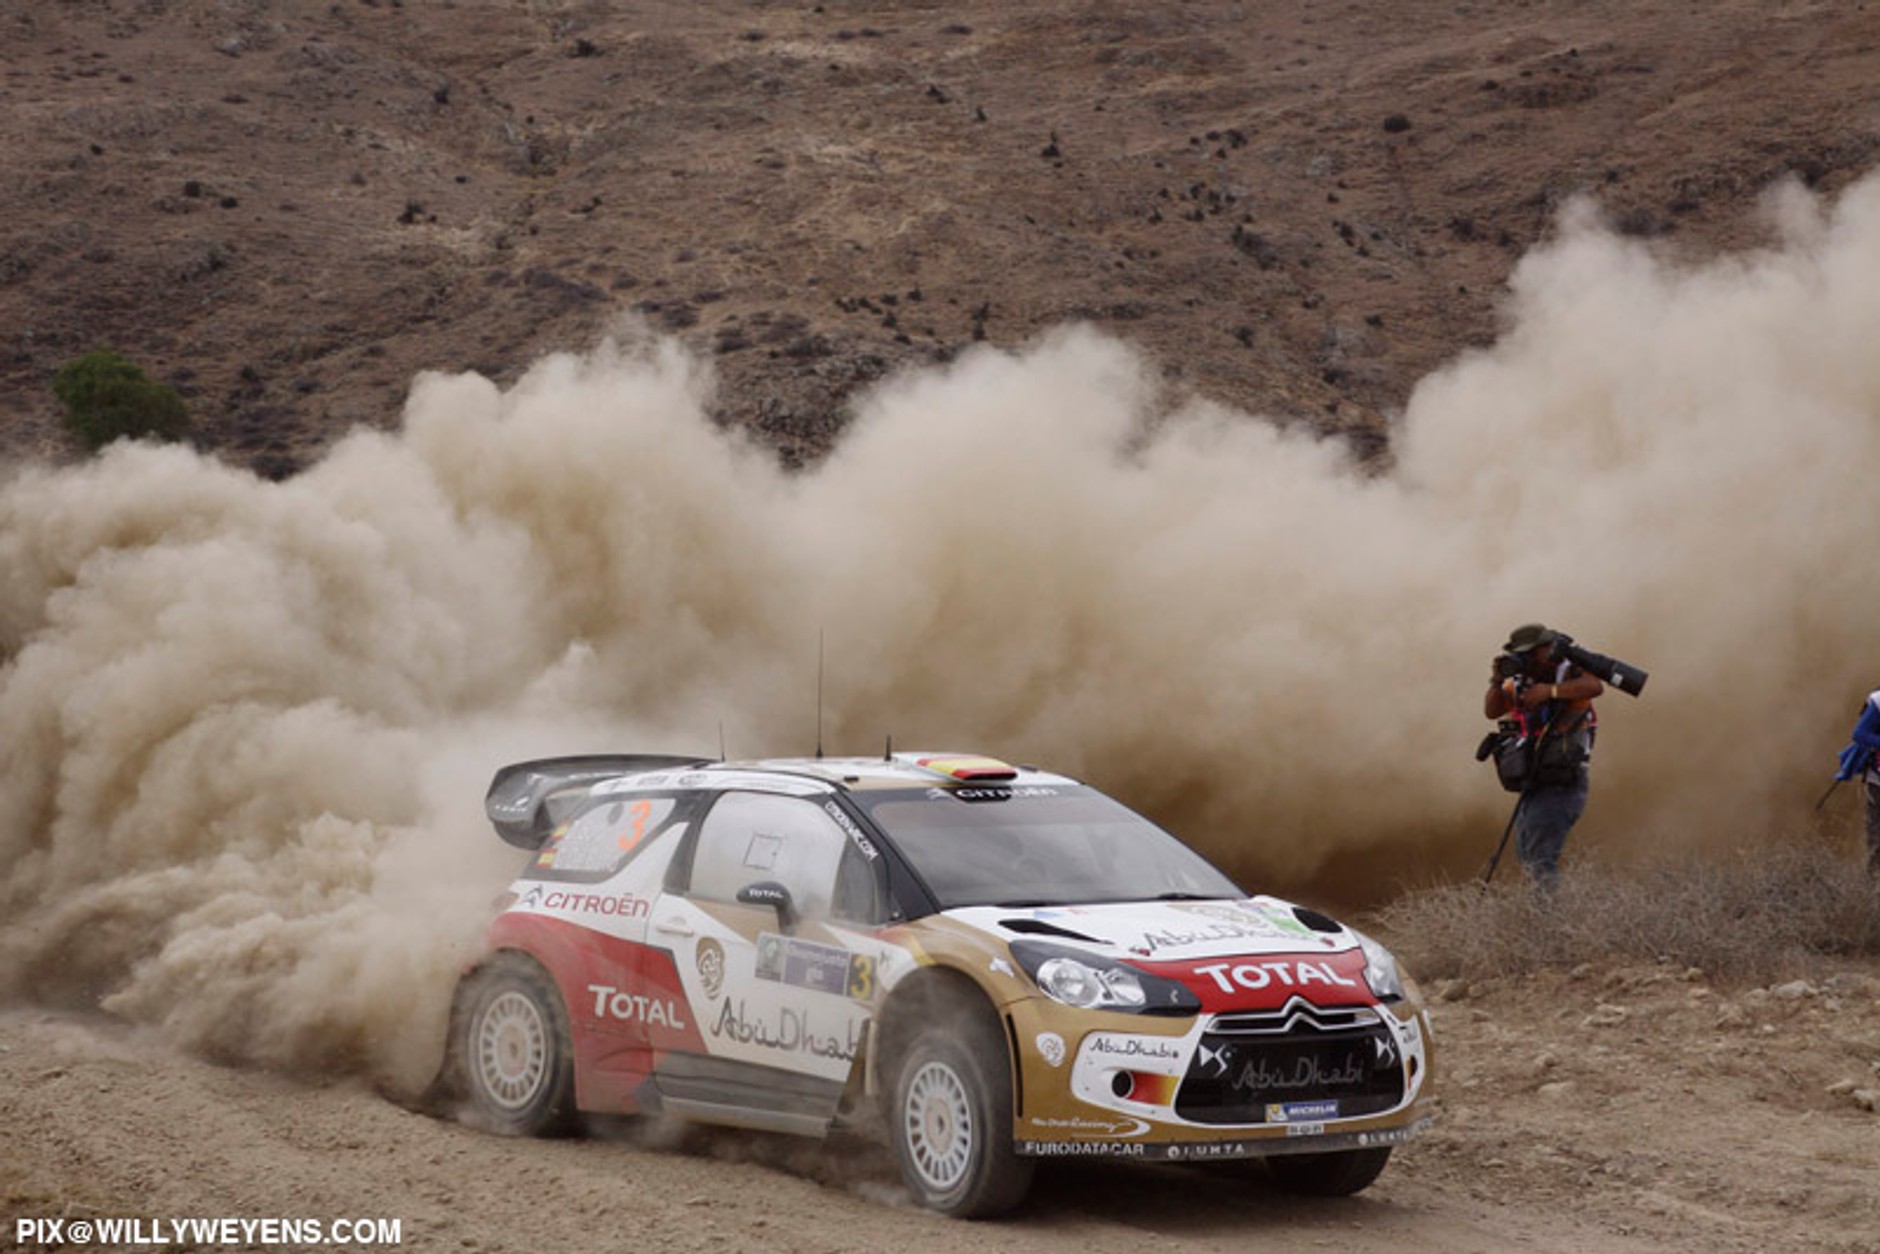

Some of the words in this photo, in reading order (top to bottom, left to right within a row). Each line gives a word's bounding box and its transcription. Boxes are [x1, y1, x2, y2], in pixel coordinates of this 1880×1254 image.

[619, 800, 650, 851] 3
[749, 888, 784, 899] TOTAL
[851, 955, 873, 1001] 3
[1194, 963, 1355, 993] TOTAL
[588, 984, 685, 1030] TOTAL
[1288, 1105, 1337, 1115] MICHELIN
